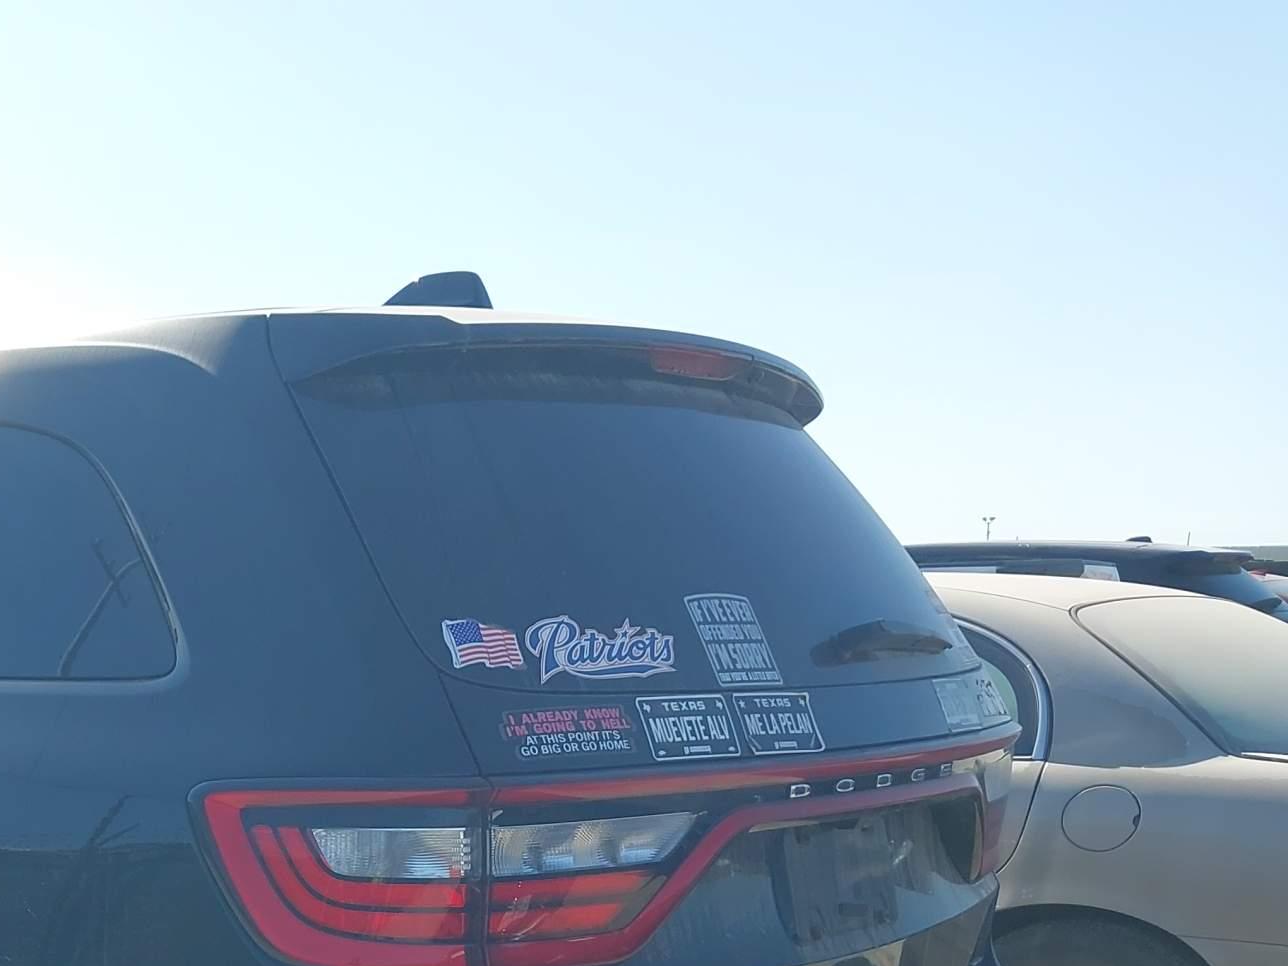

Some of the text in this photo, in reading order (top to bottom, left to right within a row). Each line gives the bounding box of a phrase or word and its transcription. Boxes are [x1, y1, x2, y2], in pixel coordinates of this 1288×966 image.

[689, 599, 754, 622] IF I'VE EVER
[526, 615, 675, 683] Patriots
[708, 643, 772, 670] I'M SORRY
[662, 701, 706, 712] TEXAS
[754, 698, 792, 708] TEXAS
[522, 710, 578, 724] ALREADY
[584, 708, 619, 719] KNOW
[744, 713, 814, 736] ME LA PELAN
[506, 718, 631, 737] I'M GOING TO HELL
[526, 729, 621, 746] AT THIS POINT IT'S
[648, 715, 730, 743] MUEVETE ALV
[521, 739, 631, 757] GO BIG OR GO HOME
[789, 763, 953, 799] DODGE
